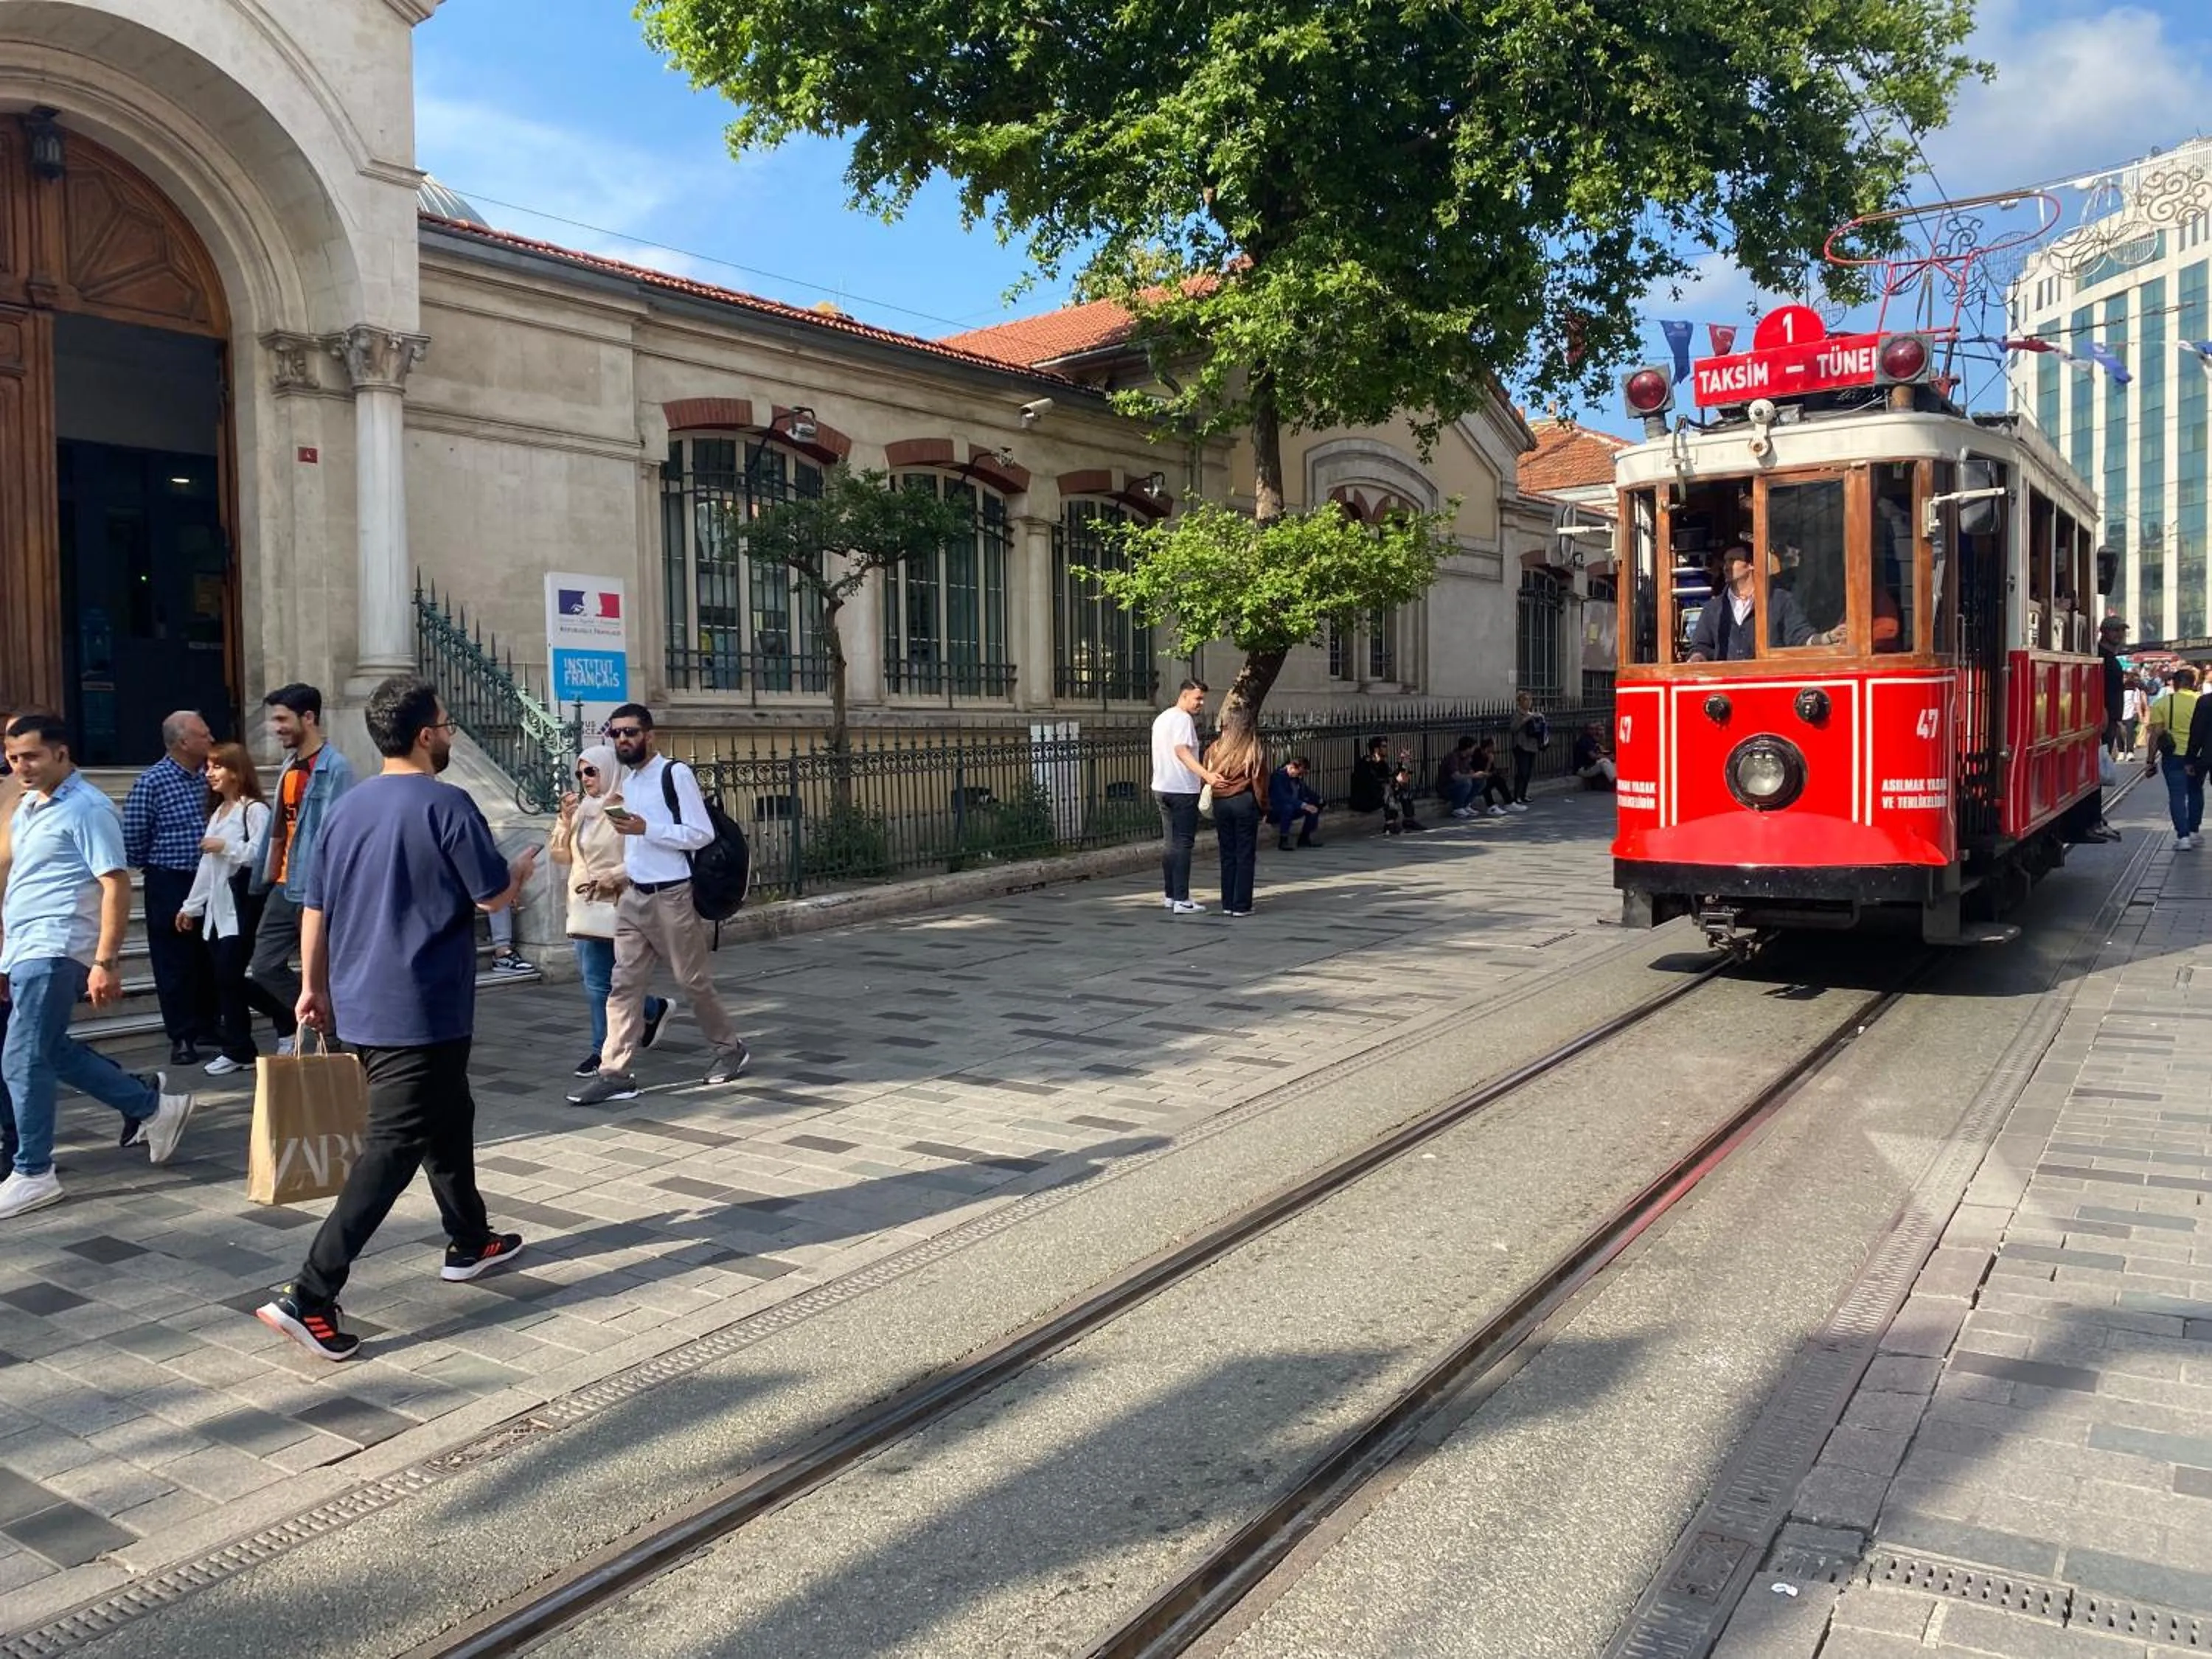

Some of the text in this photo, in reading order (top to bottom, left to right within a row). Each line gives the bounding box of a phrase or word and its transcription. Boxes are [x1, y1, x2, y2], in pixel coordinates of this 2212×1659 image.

[1782, 312, 1793, 343] 1
[1698, 358, 1769, 394] TAKSİM
[1916, 708, 1939, 740] 47
